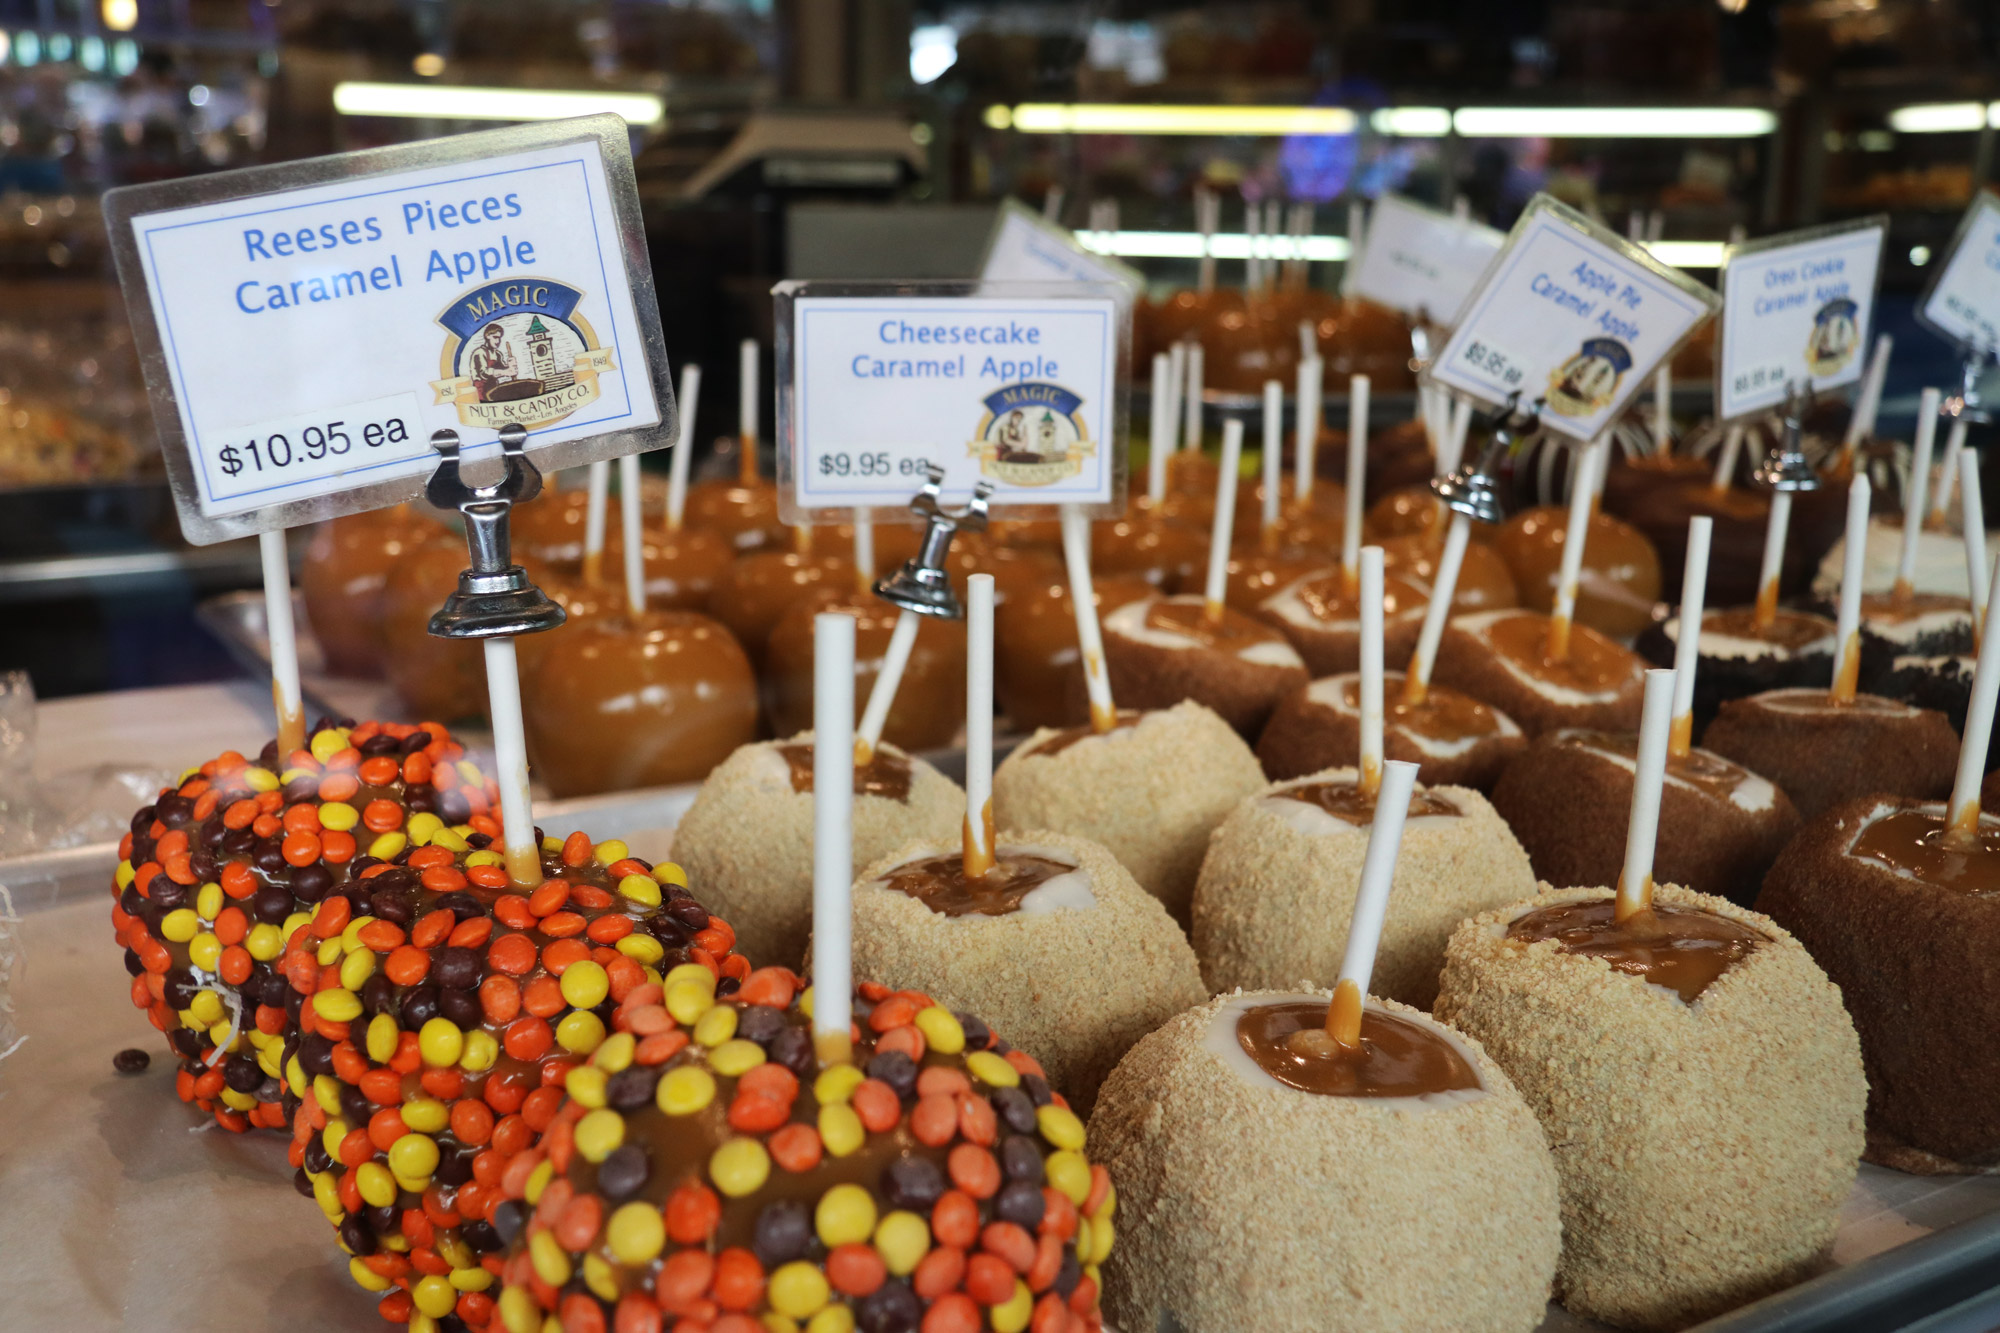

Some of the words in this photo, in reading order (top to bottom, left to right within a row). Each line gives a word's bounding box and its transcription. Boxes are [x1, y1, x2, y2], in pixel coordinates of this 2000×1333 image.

[243, 215, 382, 261] Reeses
[403, 191, 523, 235] Pieces
[235, 256, 402, 314] Caramel
[425, 235, 538, 285] Apple
[1572, 262, 1617, 297] Apple
[1618, 284, 1643, 310] Pie
[1764, 268, 1797, 289] Oreo
[1801, 257, 1845, 282] Cookie
[466, 285, 549, 322] MAGIC
[1531, 274, 1595, 318] Caramel
[1597, 310, 1639, 342] Apple
[1754, 291, 1808, 316] Caramel
[879, 321, 1041, 345] Cheesecake
[851, 355, 965, 379] Caramel
[979, 356, 1059, 383] Apple
[469, 404, 499, 418] NUT
[503, 404, 515, 417] &
[518, 393, 563, 415] CANDY
[567, 384, 590, 400] CO.
[554, 401, 578, 415] Angeles
[1003, 386, 1061, 405] MAGIC
[218, 421, 351, 478] $10.95
[362, 416, 410, 448] ea
[818, 453, 891, 477] $9.95
